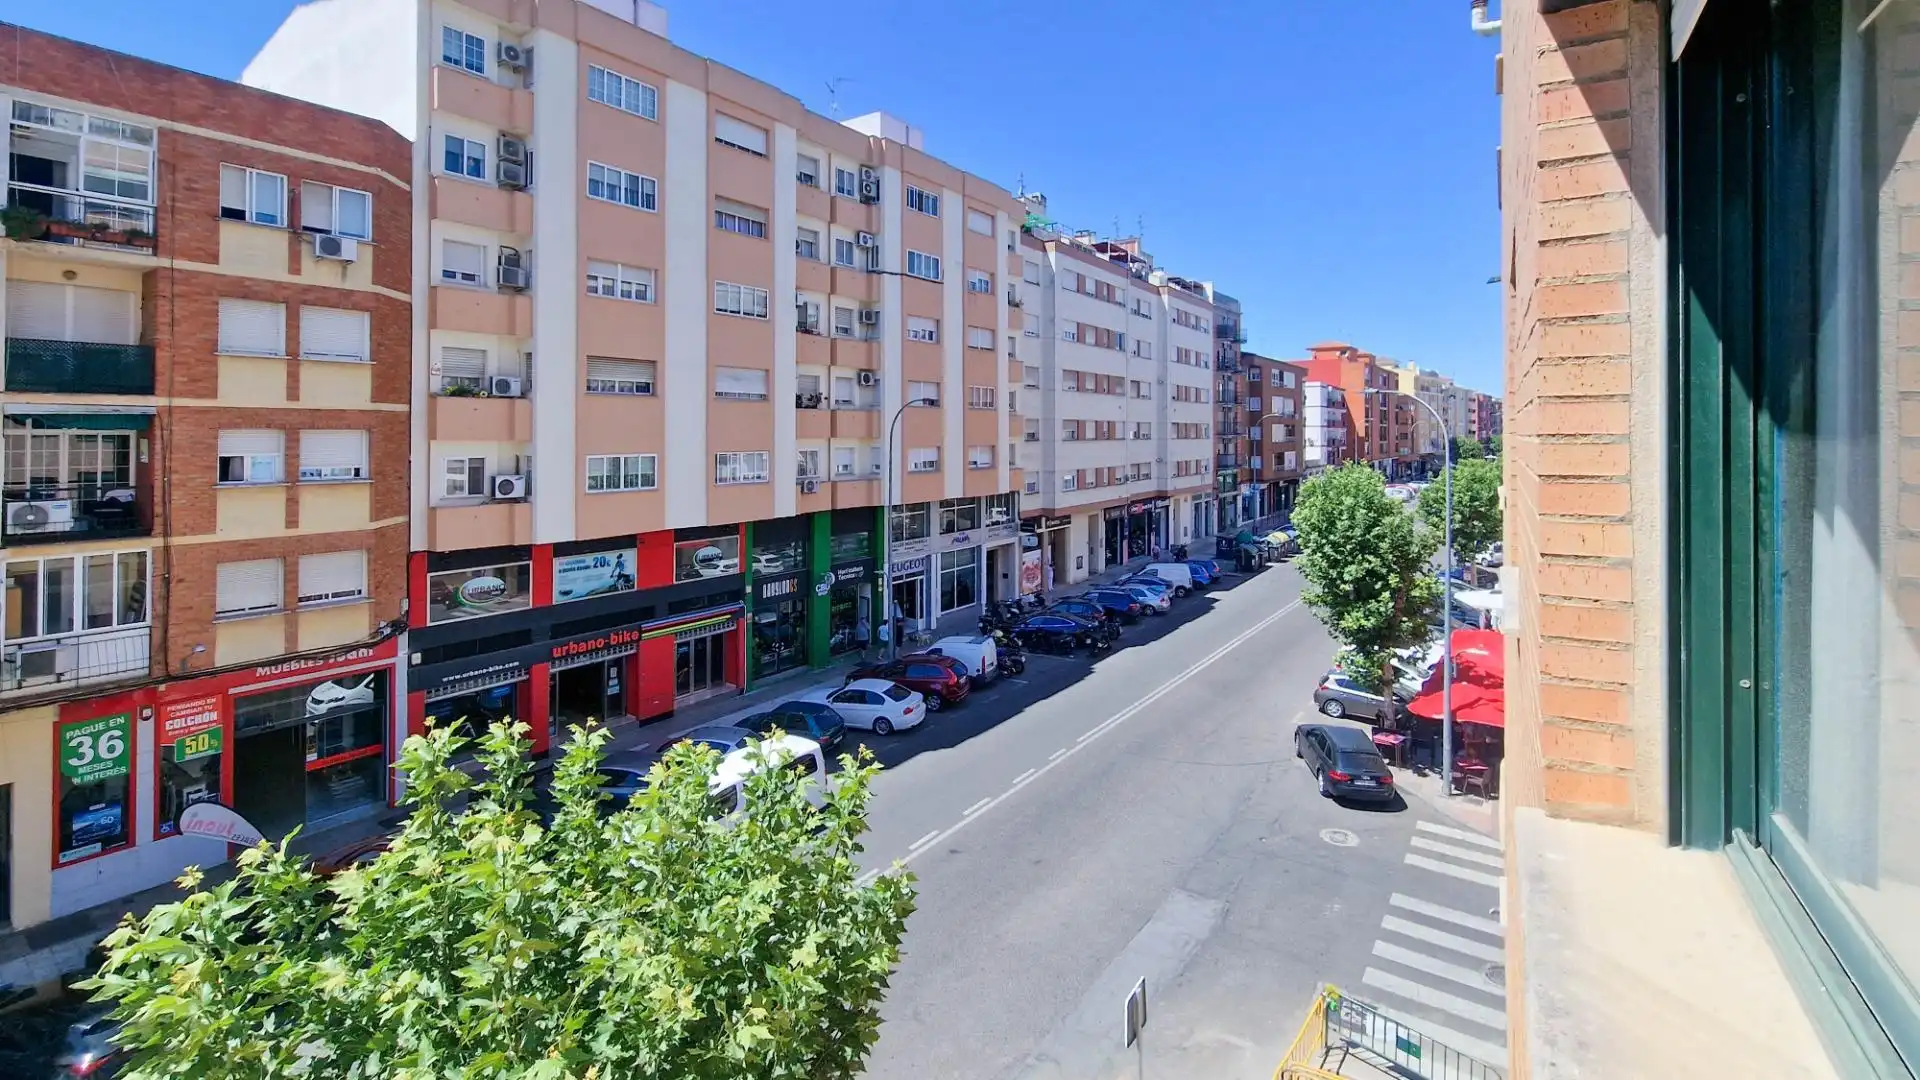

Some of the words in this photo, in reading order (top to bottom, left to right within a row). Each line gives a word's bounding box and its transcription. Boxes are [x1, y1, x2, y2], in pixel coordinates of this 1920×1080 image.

[892, 558, 925, 573] EUGEOT
[552, 630, 640, 658] urbano-bike
[256, 655, 324, 677] MUEBLES
[442, 661, 519, 682] www.urbano-bike.com
[66, 722, 107, 740] PAGUE
[109, 716, 125, 728] EN
[68, 729, 124, 767] 36
[78, 760, 114, 775] MESES
